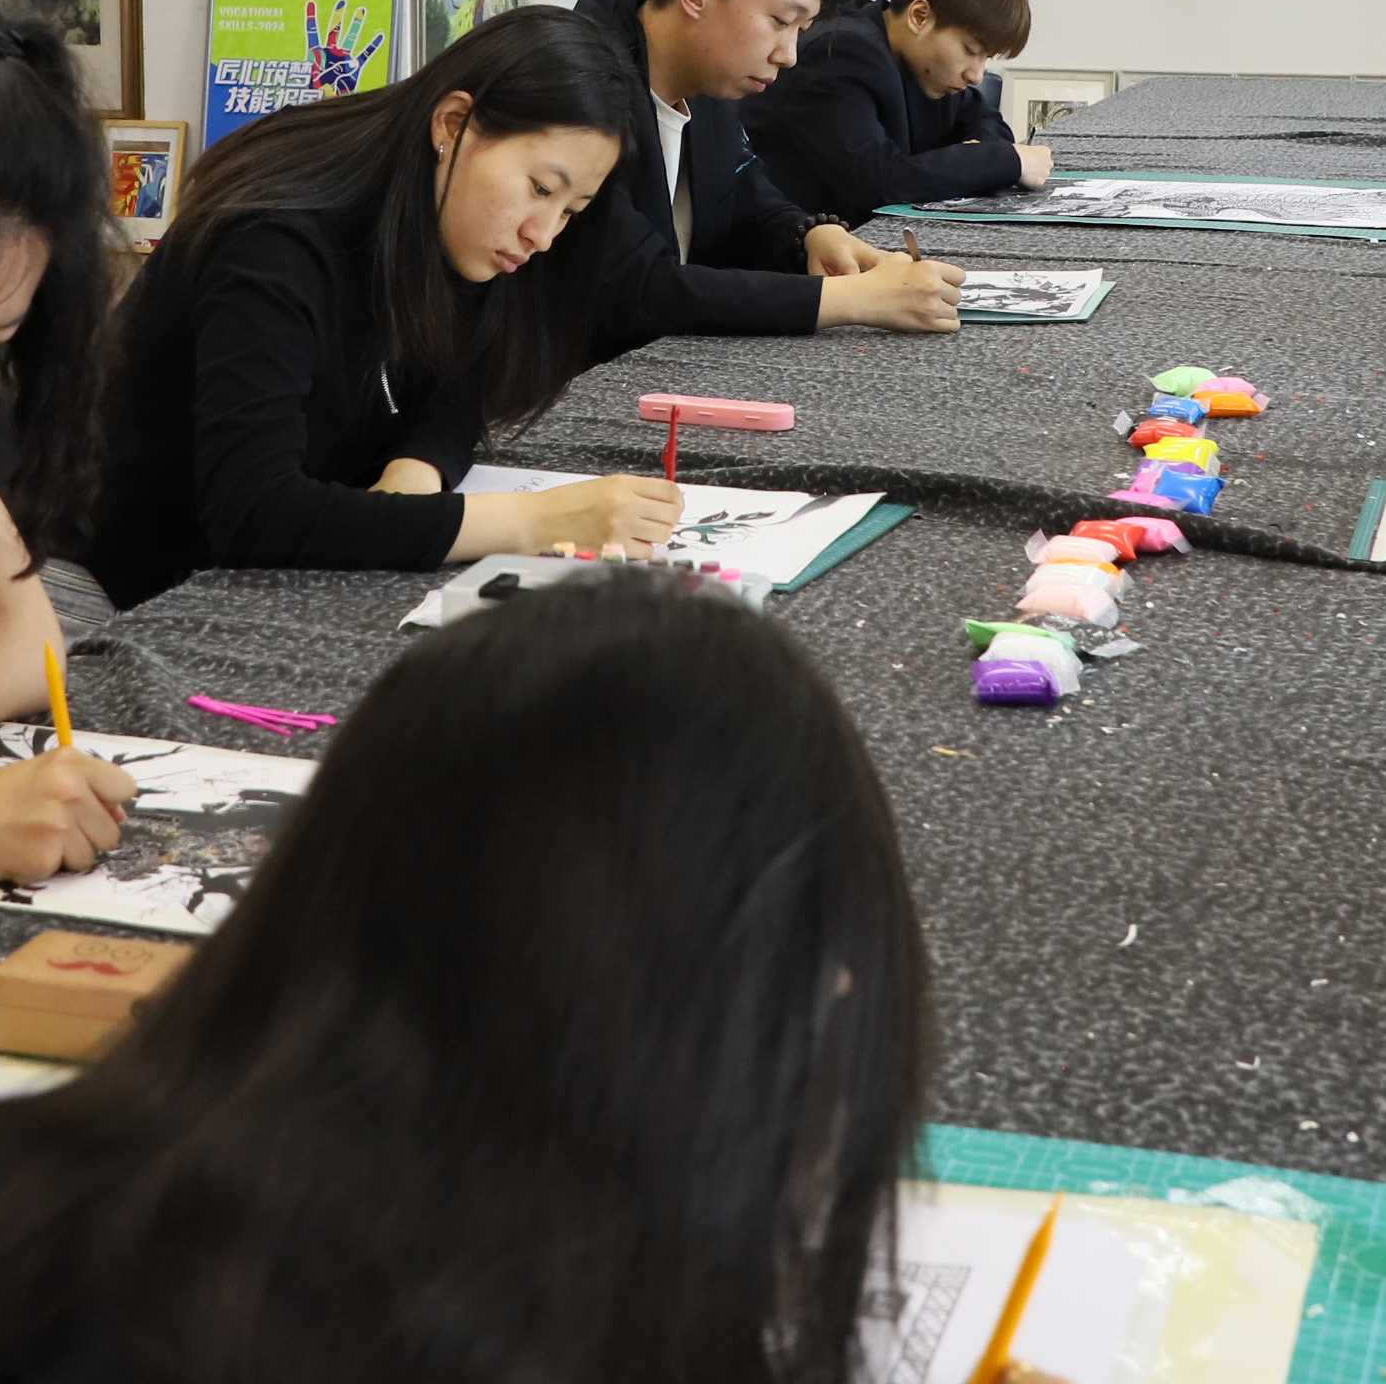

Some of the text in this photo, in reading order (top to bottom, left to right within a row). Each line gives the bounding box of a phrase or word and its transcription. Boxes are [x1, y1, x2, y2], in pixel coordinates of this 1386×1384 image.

[219, 7, 283, 17] VOCATIONAL
[214, 59, 313, 87] 匠心筑梦
